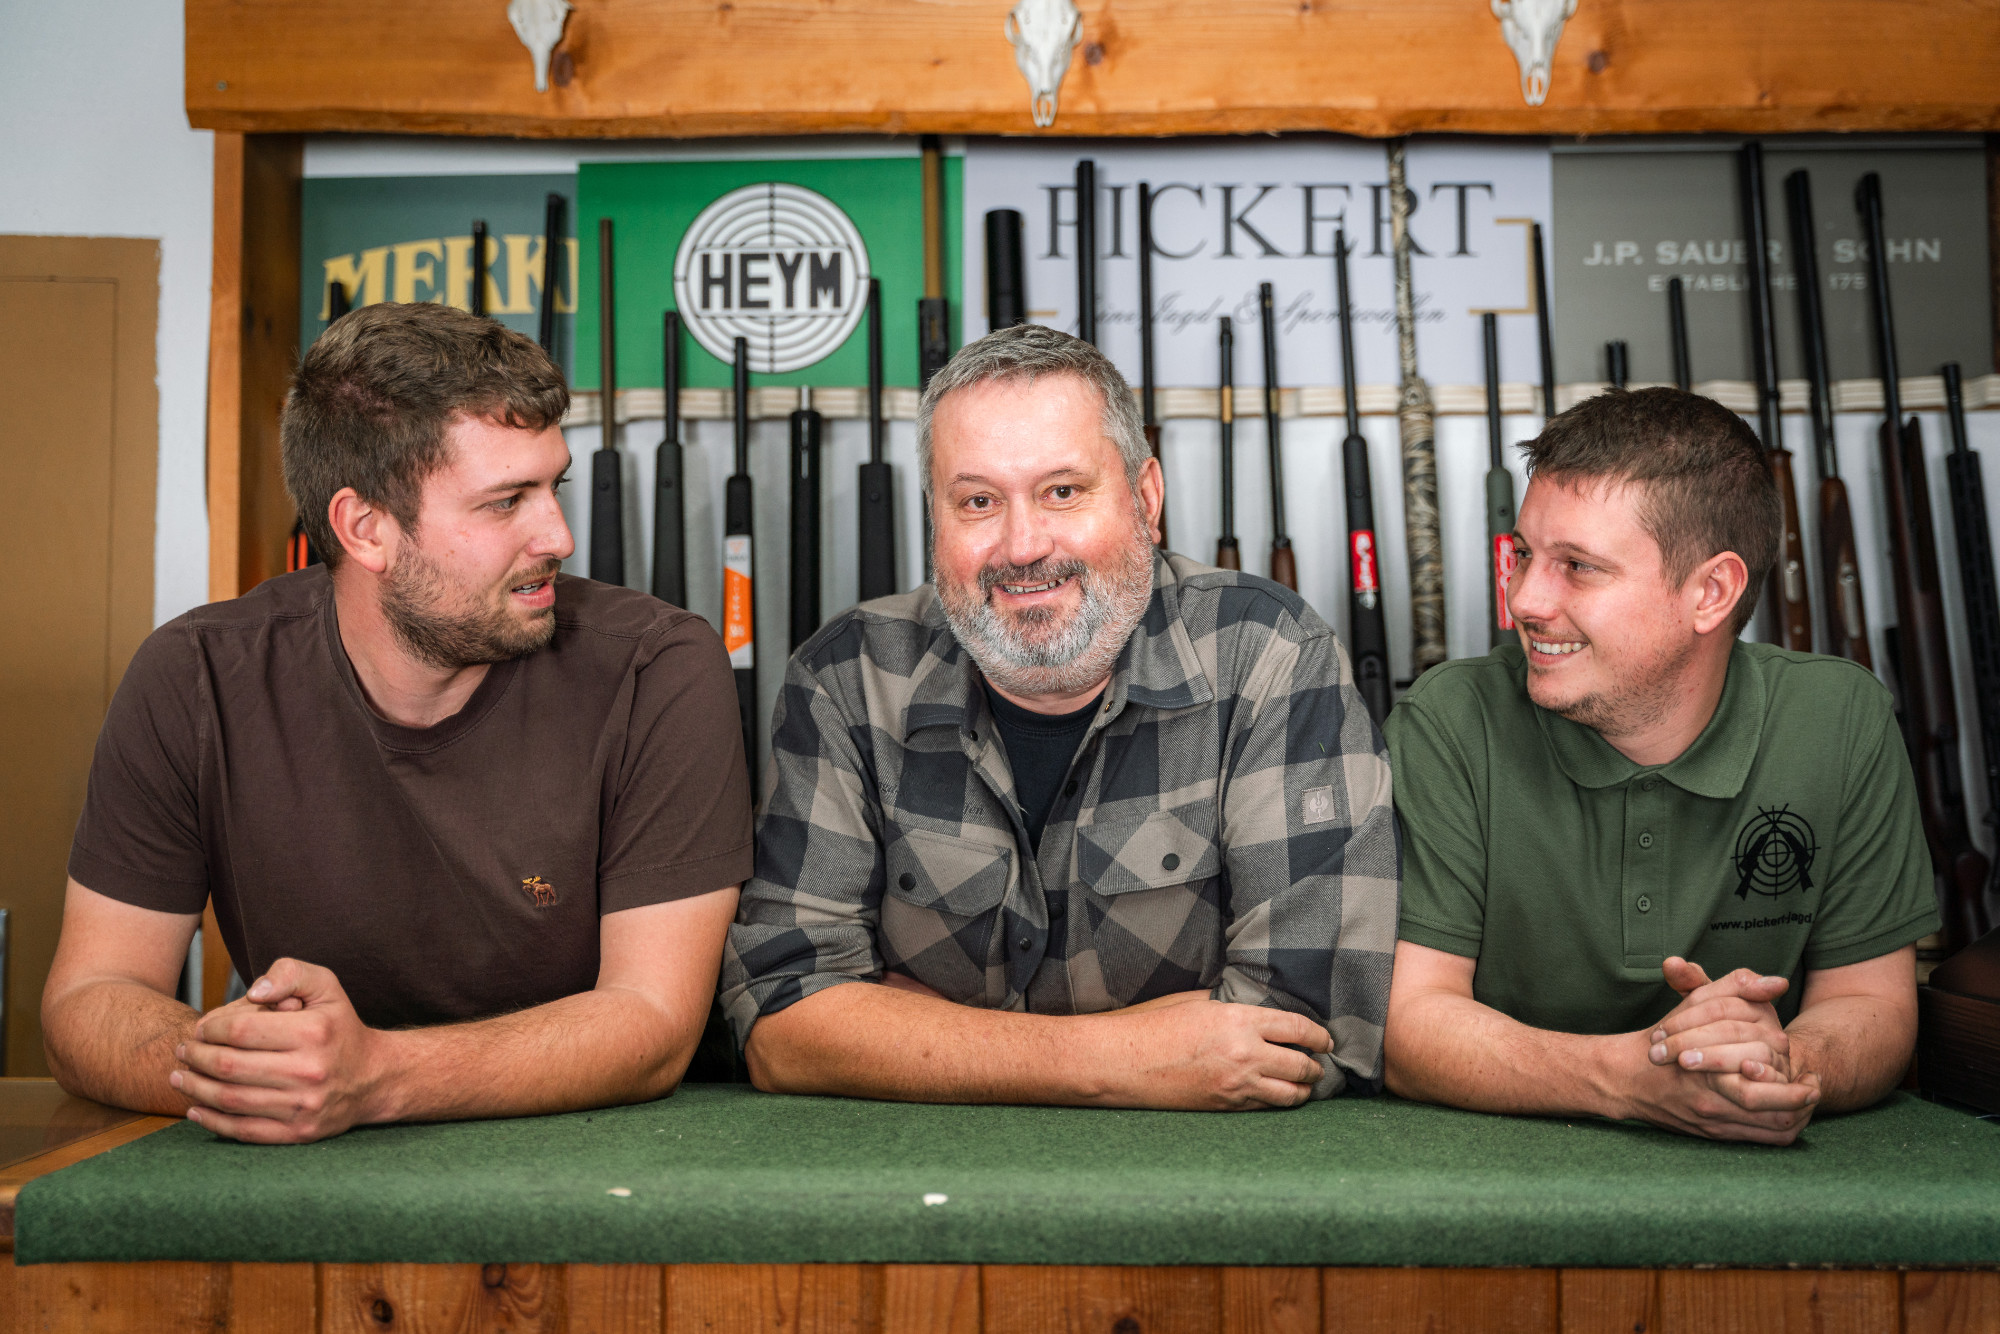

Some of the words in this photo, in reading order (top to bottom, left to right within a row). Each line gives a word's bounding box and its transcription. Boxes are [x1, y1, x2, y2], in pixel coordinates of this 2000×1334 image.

[318, 234, 579, 321] MERK
[702, 252, 841, 309] HEYM
[1583, 240, 1644, 266] J.P.
